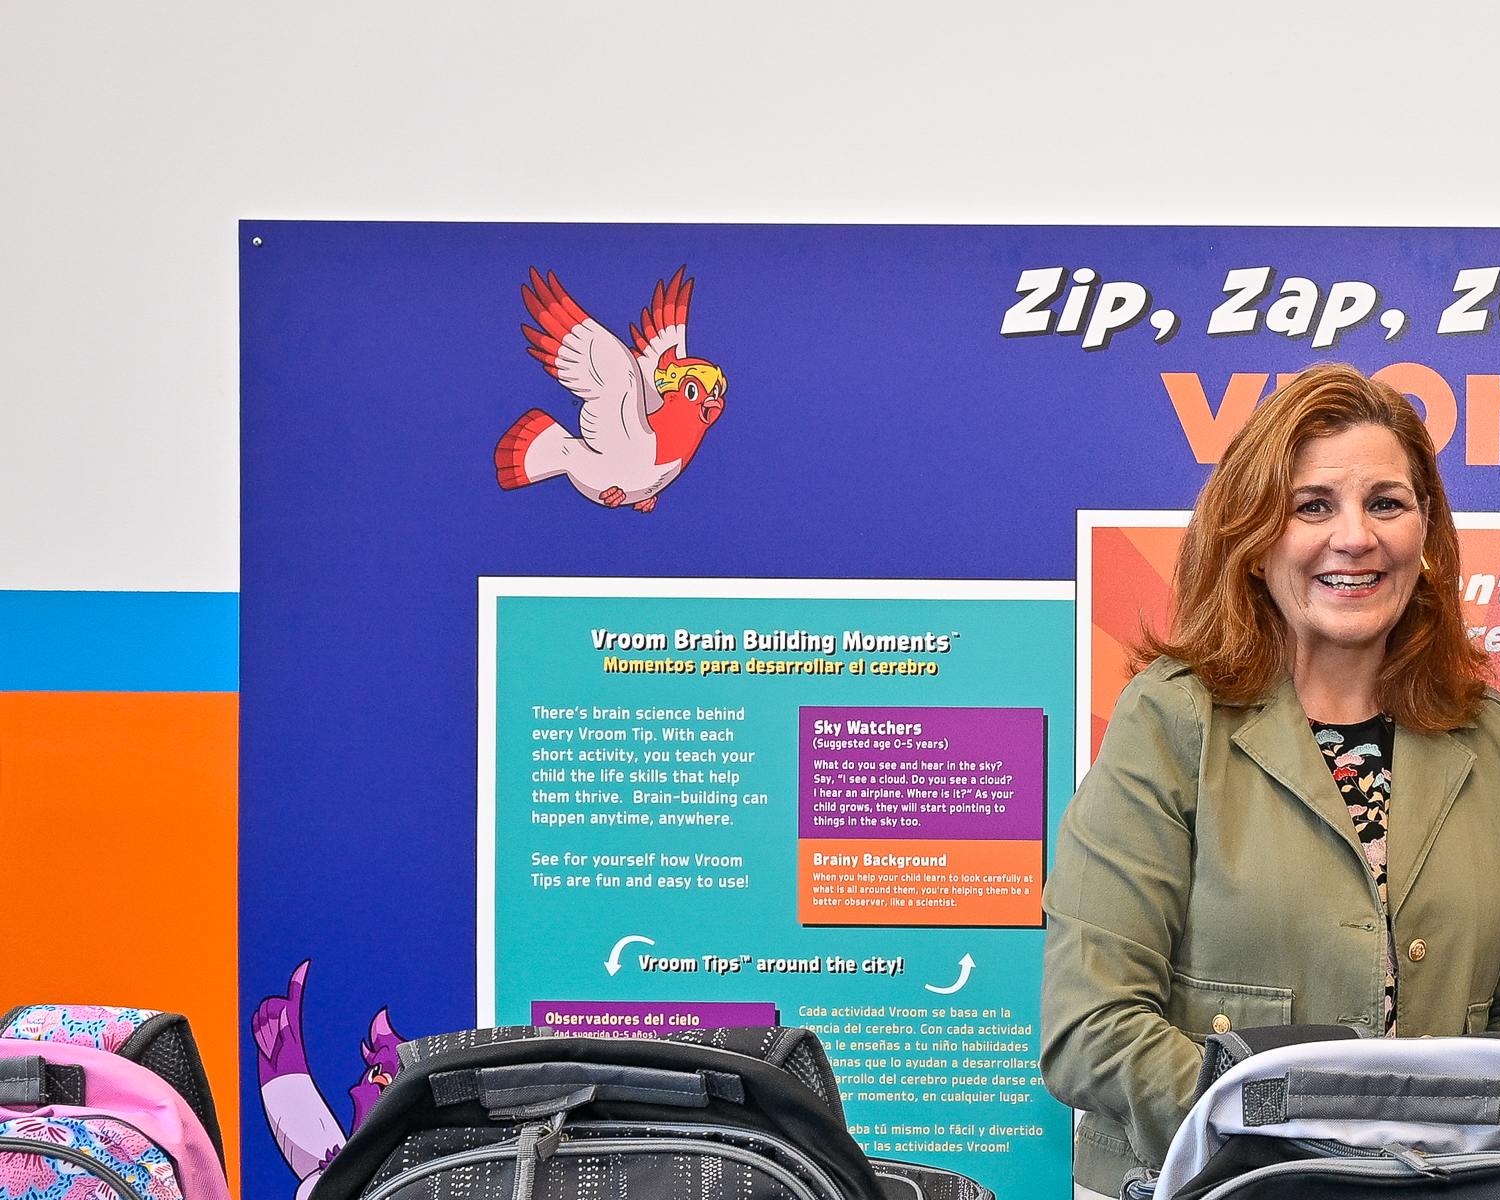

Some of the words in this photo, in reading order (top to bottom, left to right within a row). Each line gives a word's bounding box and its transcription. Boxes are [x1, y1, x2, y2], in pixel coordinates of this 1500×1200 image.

[1000, 267, 1174, 347] Zip,
[1207, 267, 1404, 347] Zap,
[591, 629, 665, 649] Vroom
[675, 629, 733, 649] Brain
[744, 630, 837, 653] Building
[604, 656, 697, 675] Momentos
[701, 661, 742, 676] para
[746, 655, 846, 676] desarrollar
[849, 659, 867, 676] el
[870, 658, 939, 677] cerebro
[532, 706, 587, 719] There's
[593, 706, 629, 719] brain
[636, 707, 691, 720] science
[697, 707, 744, 720] behind
[533, 730, 573, 742] every
[579, 727, 626, 740] Vroom
[632, 728, 657, 744] Tip.
[662, 728, 694, 741] With
[700, 728, 733, 741] each
[815, 720, 841, 736] Sky
[847, 721, 921, 735] Watchers
[812, 736, 870, 751] (Suggested
[873, 740, 891, 751] age
[893, 738, 913, 749] 0-5
[915, 737, 949, 751] years)
[532, 748, 573, 761] short
[579, 748, 638, 763] activity,
[644, 752, 669, 763] you
[675, 749, 716, 762] teach
[722, 752, 755, 764] your
[532, 769, 564, 782] child
[571, 769, 595, 782] the
[601, 769, 624, 782] life
[630, 769, 667, 782] skills
[673, 770, 704, 782] that
[710, 770, 739, 786] help
[532, 790, 569, 803] them
[575, 790, 622, 803] thrive.
[634, 790, 737, 807] Brain-building
[743, 794, 767, 804] can
[532, 810, 584, 827] happen
[591, 811, 653, 826] anytime,
[659, 812, 733, 826] anywhere.
[814, 853, 858, 868] Brainy
[864, 854, 946, 868] Background
[639, 955, 695, 971] Vroom
[757, 956, 822, 973] around
[826, 956, 858, 973] the
[862, 956, 901, 975] city!
[545, 1011, 640, 1026] Observadores
[644, 1013, 663, 1025] del
[669, 1014, 699, 1025] cielo
[799, 1006, 827, 1016] Cada
[831, 1006, 884, 1016] actividad
[889, 1007, 927, 1017] Vroom
[932, 1009, 945, 1017] se
[951, 1007, 977, 1017] basa
[1001, 1008, 1010, 1018] la
